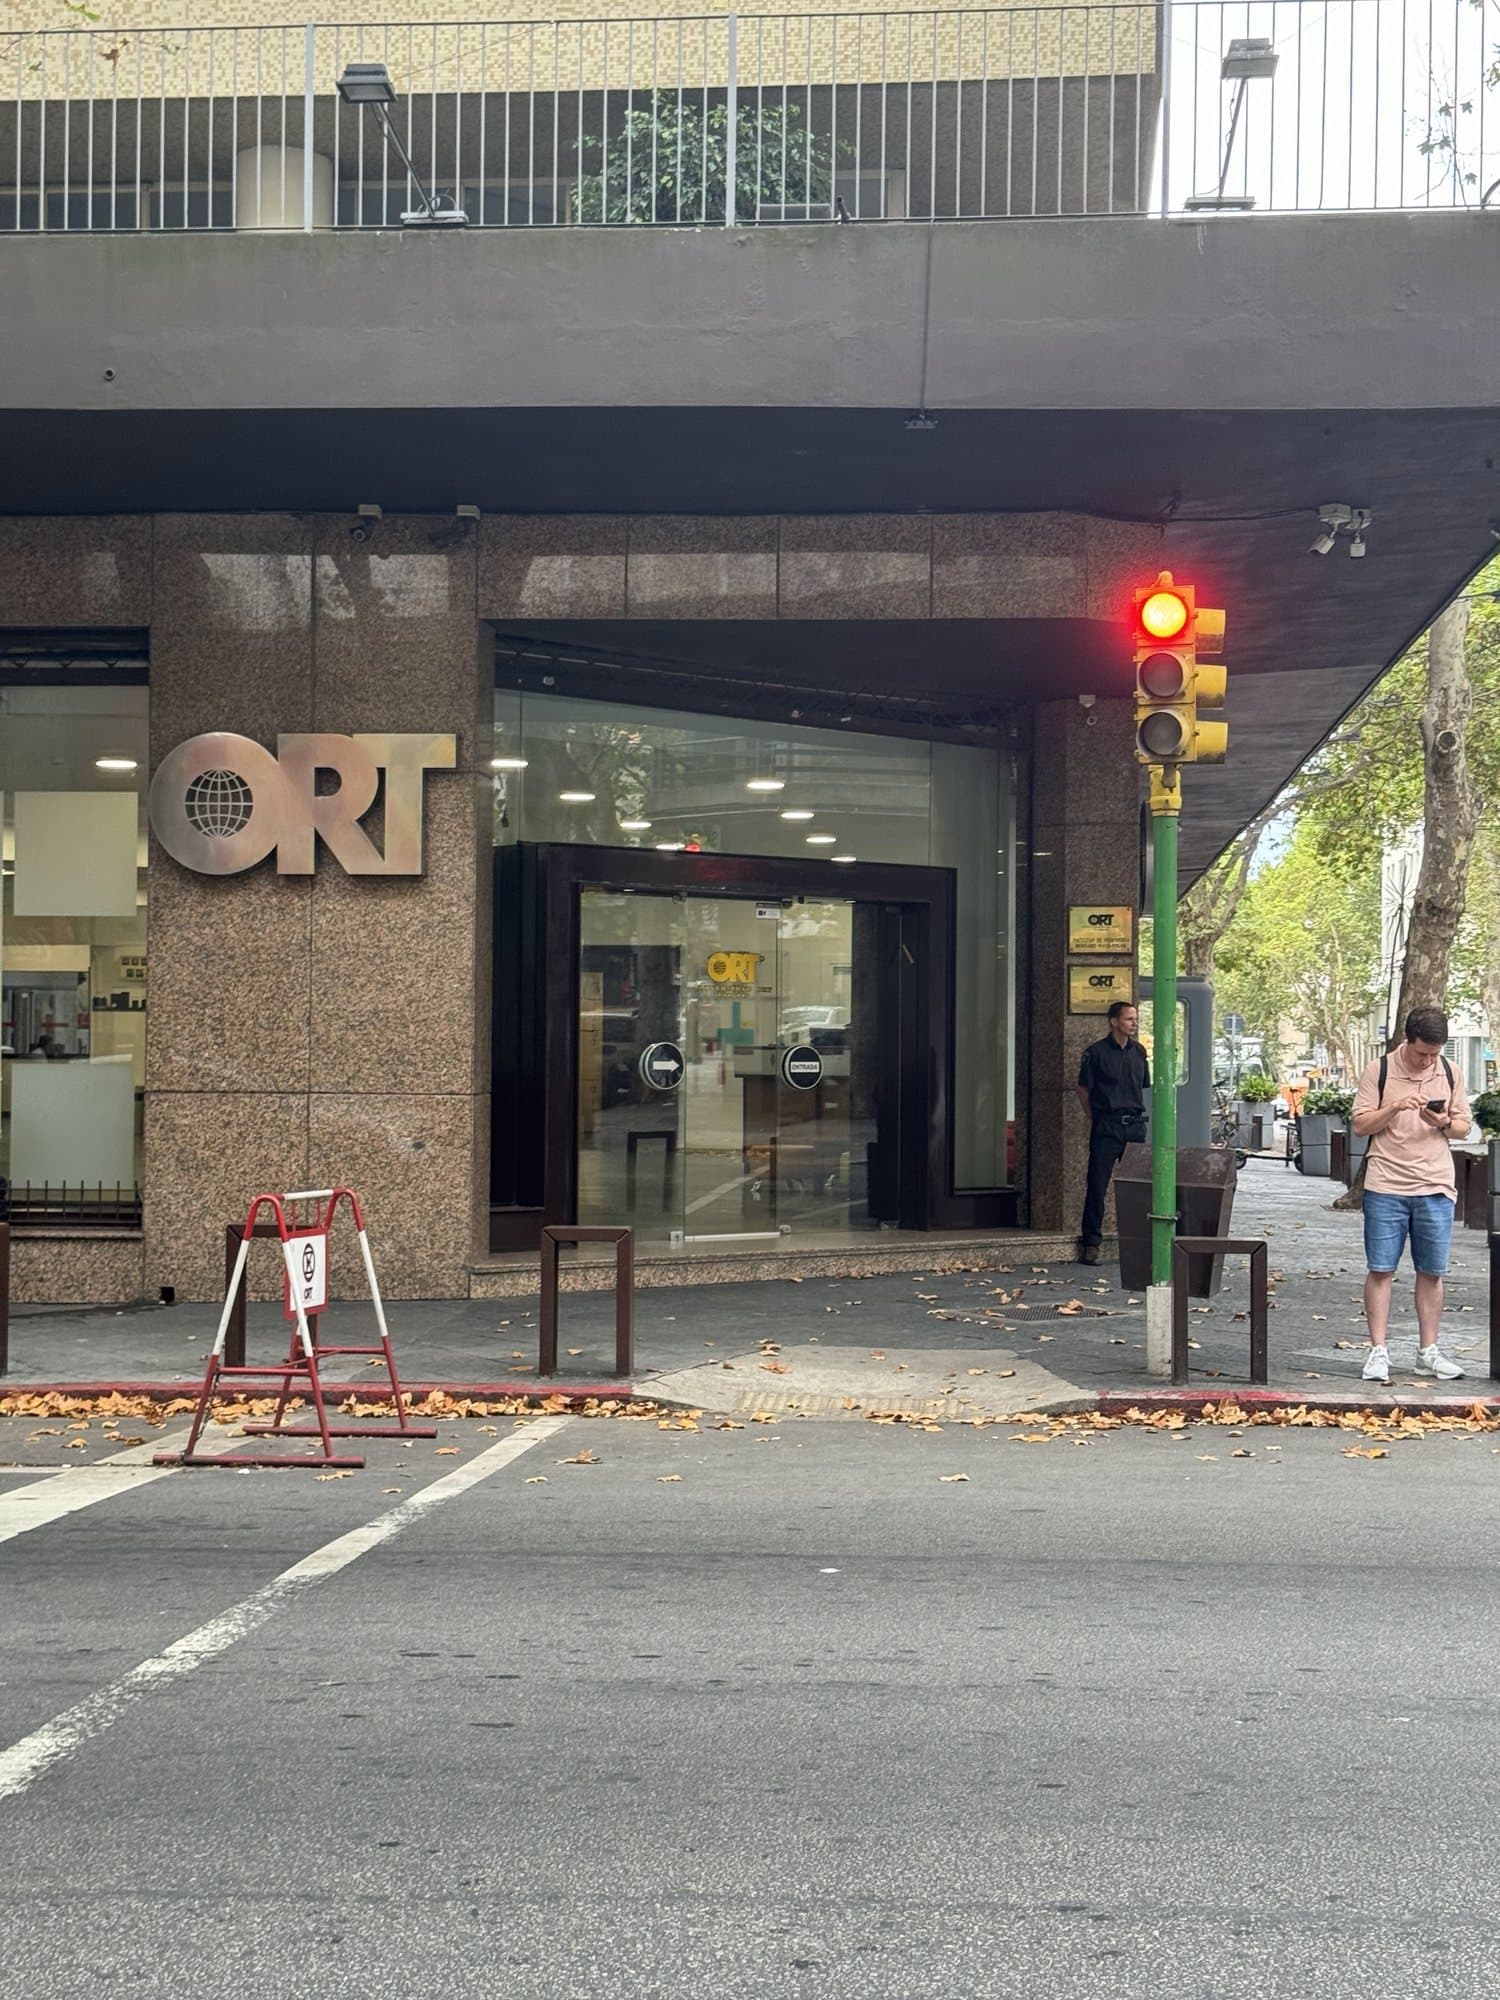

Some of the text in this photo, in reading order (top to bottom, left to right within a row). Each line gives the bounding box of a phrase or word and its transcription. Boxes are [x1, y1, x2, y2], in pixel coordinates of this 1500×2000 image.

[150, 732, 456, 875] ORT
[1088, 914, 1114, 926] ORT
[707, 952, 760, 983] ORT
[1088, 975, 1114, 986] ORT
